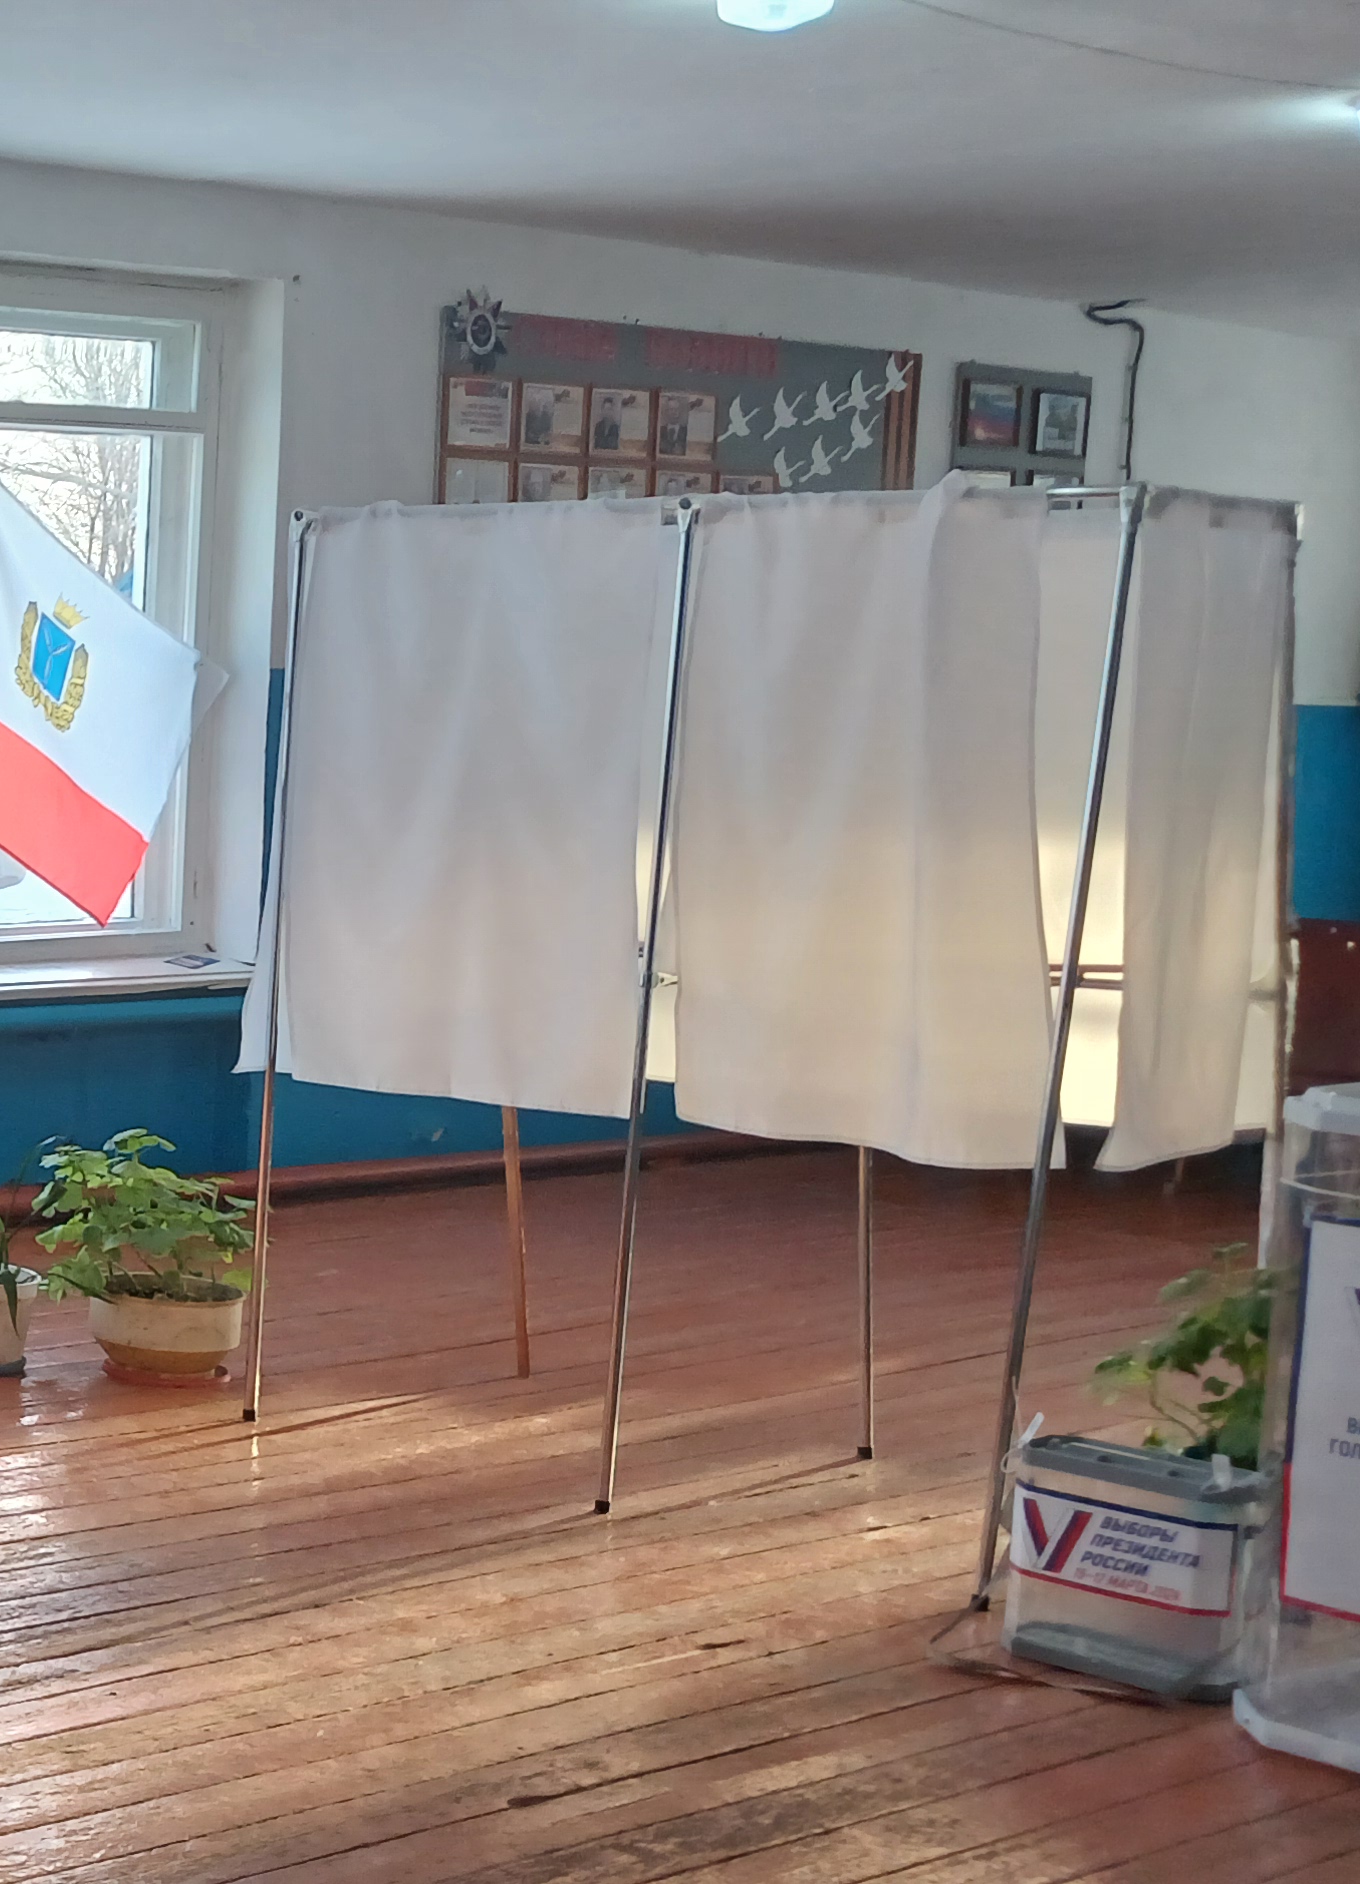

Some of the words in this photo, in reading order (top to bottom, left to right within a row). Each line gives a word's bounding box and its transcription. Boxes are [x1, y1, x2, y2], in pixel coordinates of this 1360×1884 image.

[1099, 1515, 1180, 1543] ВЫБОРЫ
[1080, 1550, 1152, 1577] РОССИИ
[1089, 1533, 1202, 1569] ПРЕЗИДЕНТА
